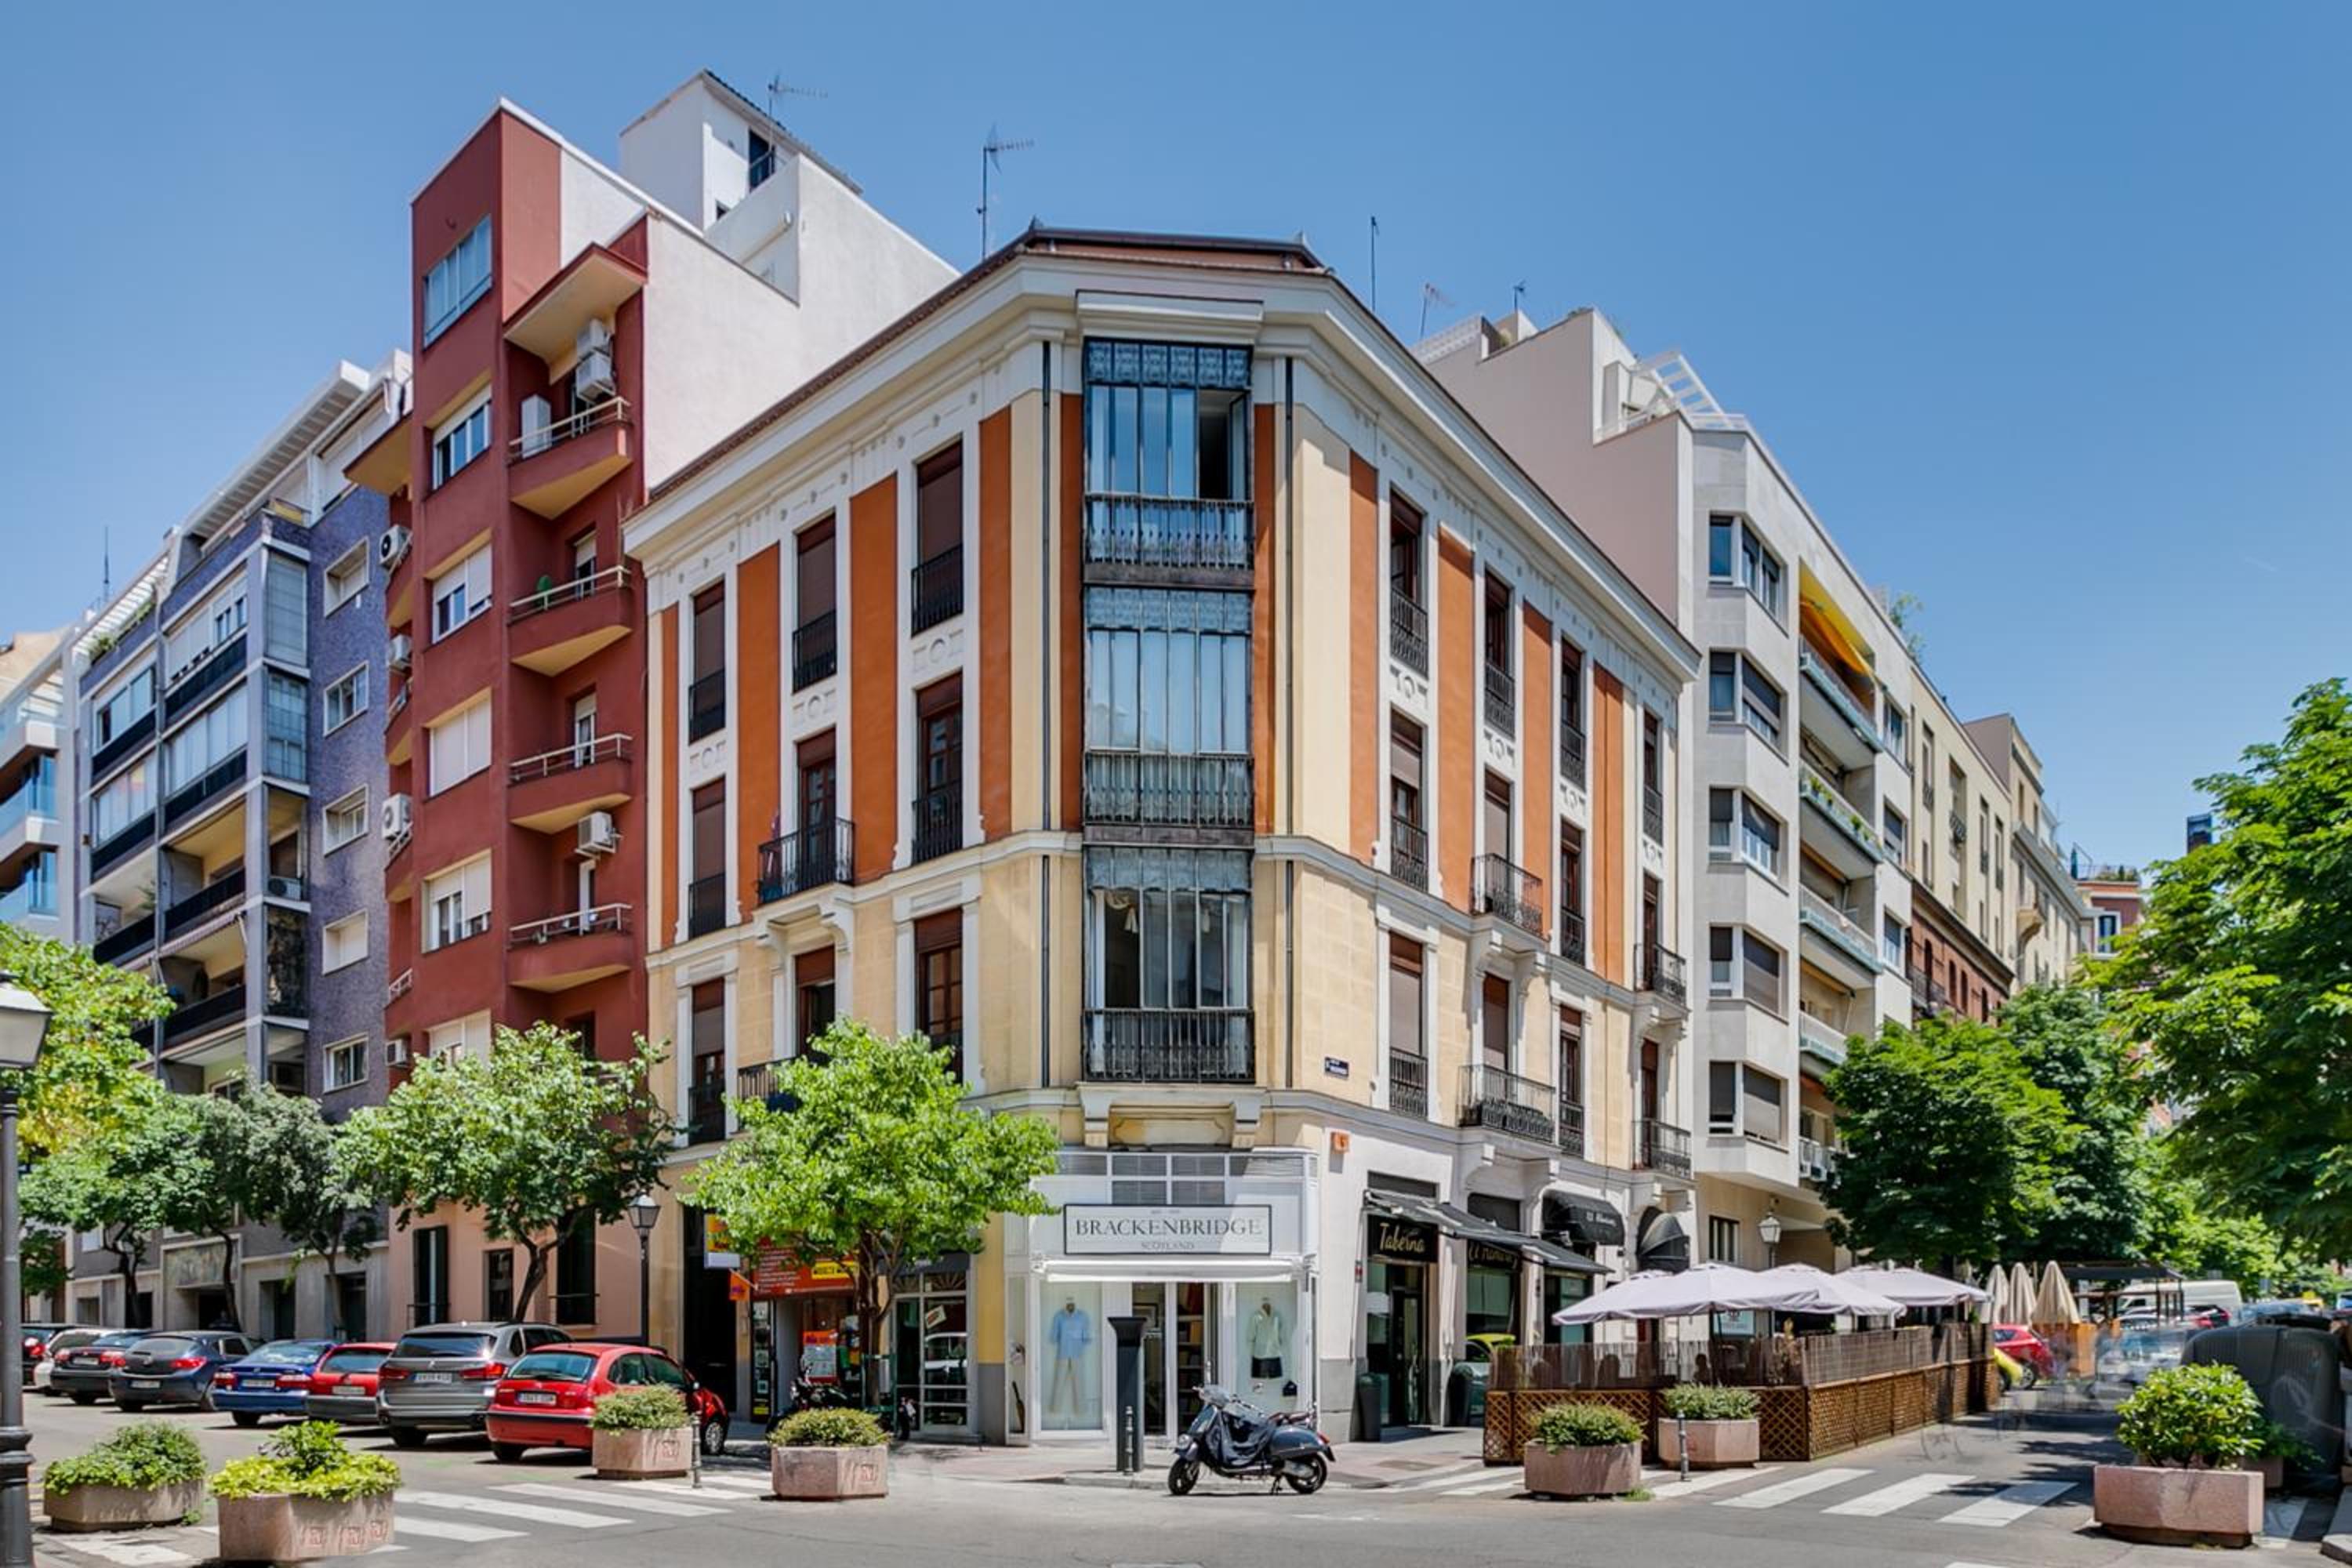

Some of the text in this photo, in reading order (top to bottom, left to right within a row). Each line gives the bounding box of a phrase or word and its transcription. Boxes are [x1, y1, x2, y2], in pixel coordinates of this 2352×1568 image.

[1076, 1218, 1263, 1236] BRACKENBRIDGE
[1141, 1241, 1195, 1250] SCOTLAND
[1379, 1222, 1425, 1253] Taberna
